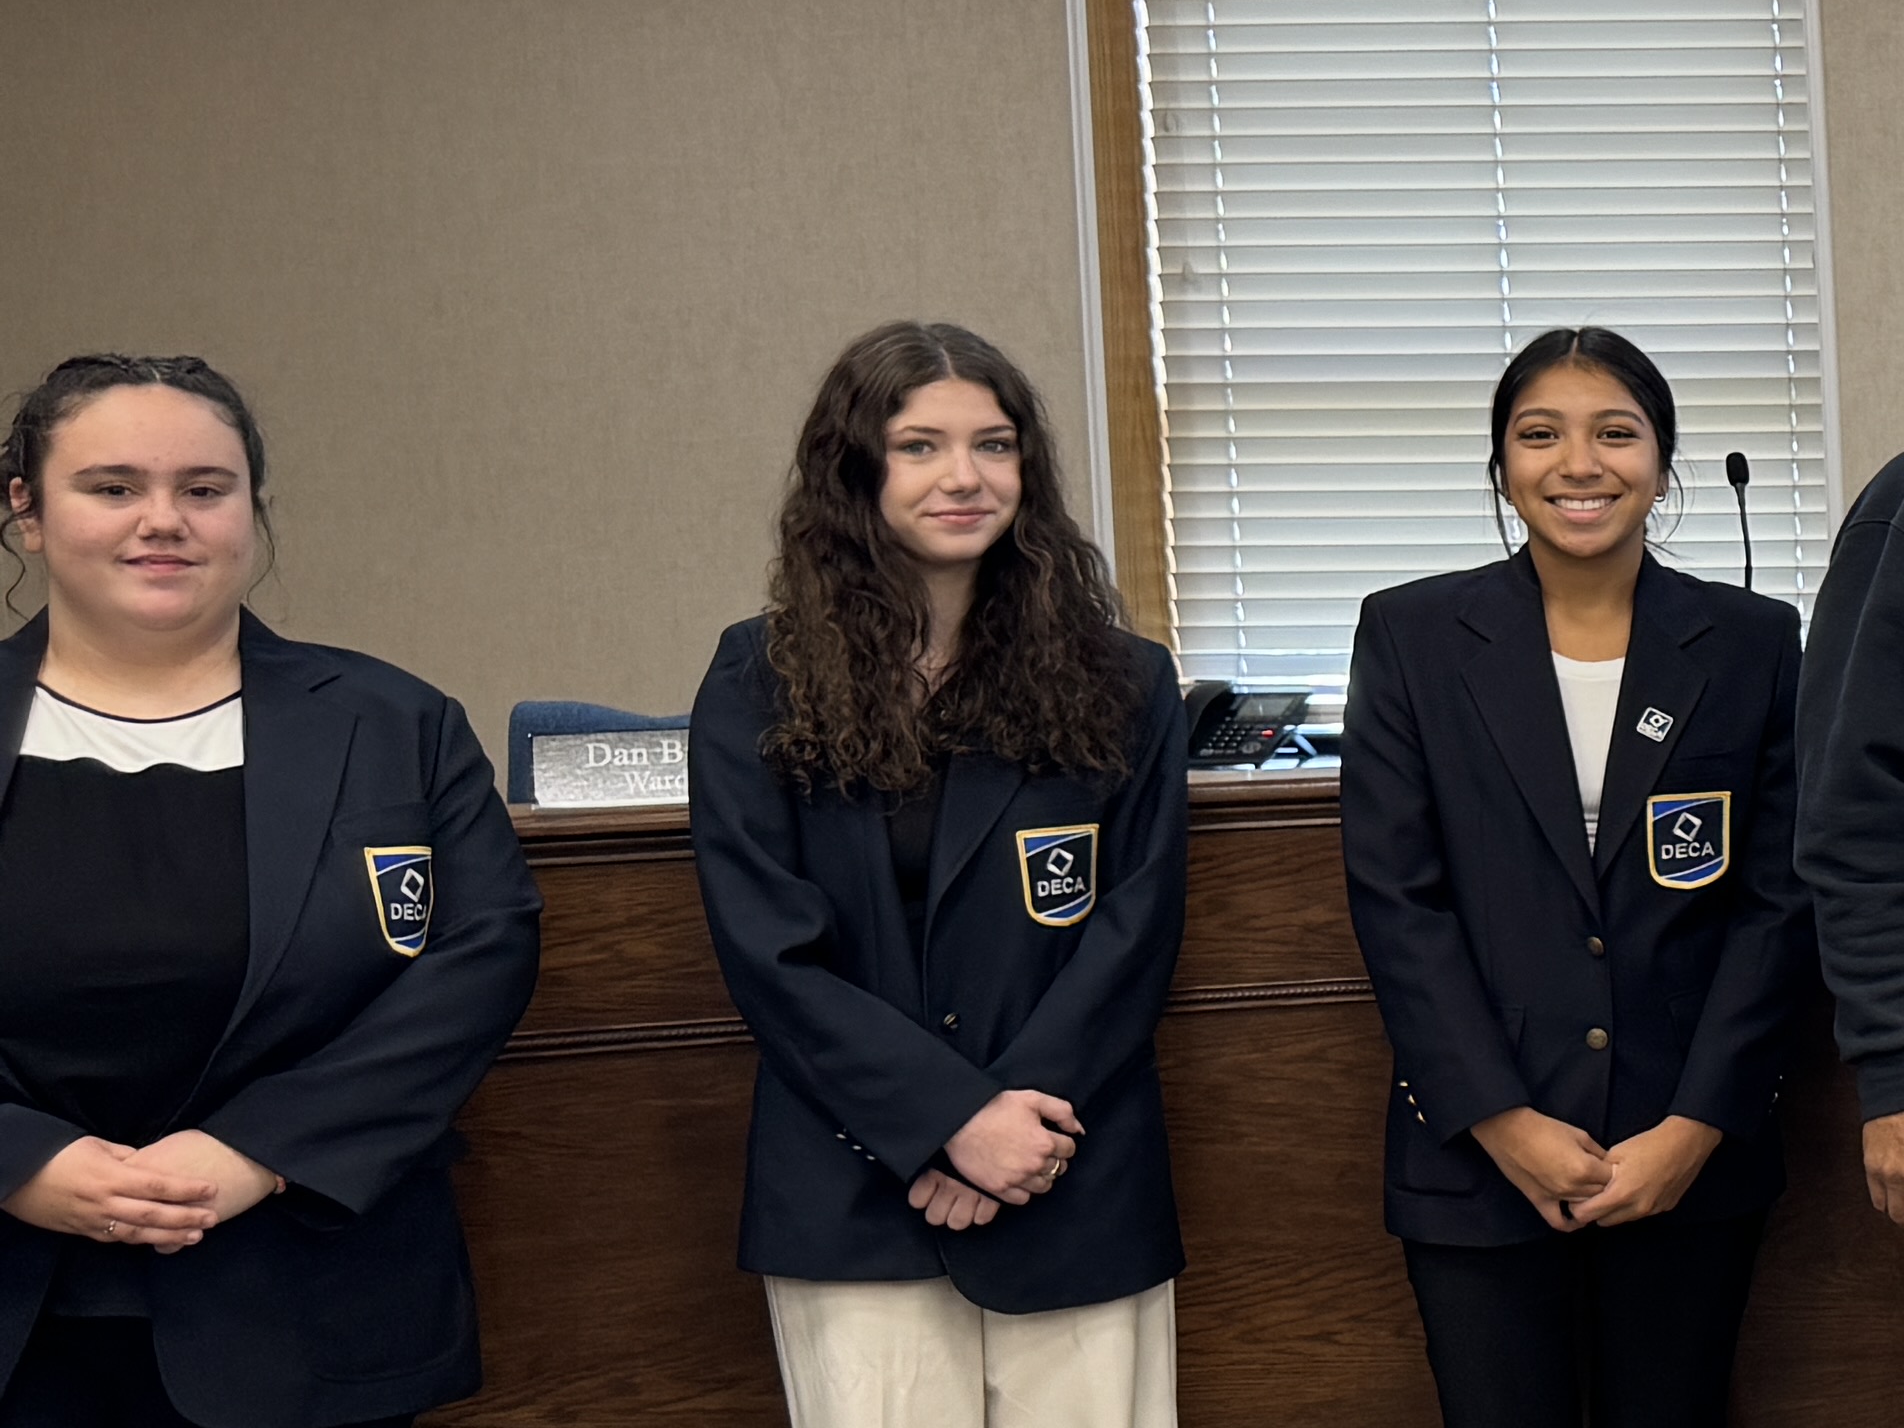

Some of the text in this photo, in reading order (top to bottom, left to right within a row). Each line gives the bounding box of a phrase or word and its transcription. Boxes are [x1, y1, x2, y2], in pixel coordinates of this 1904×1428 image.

[584, 738, 684, 769] Dan B
[1661, 841, 1715, 860] DECA
[1037, 876, 1086, 897] DECA
[389, 902, 428, 921] DEC
